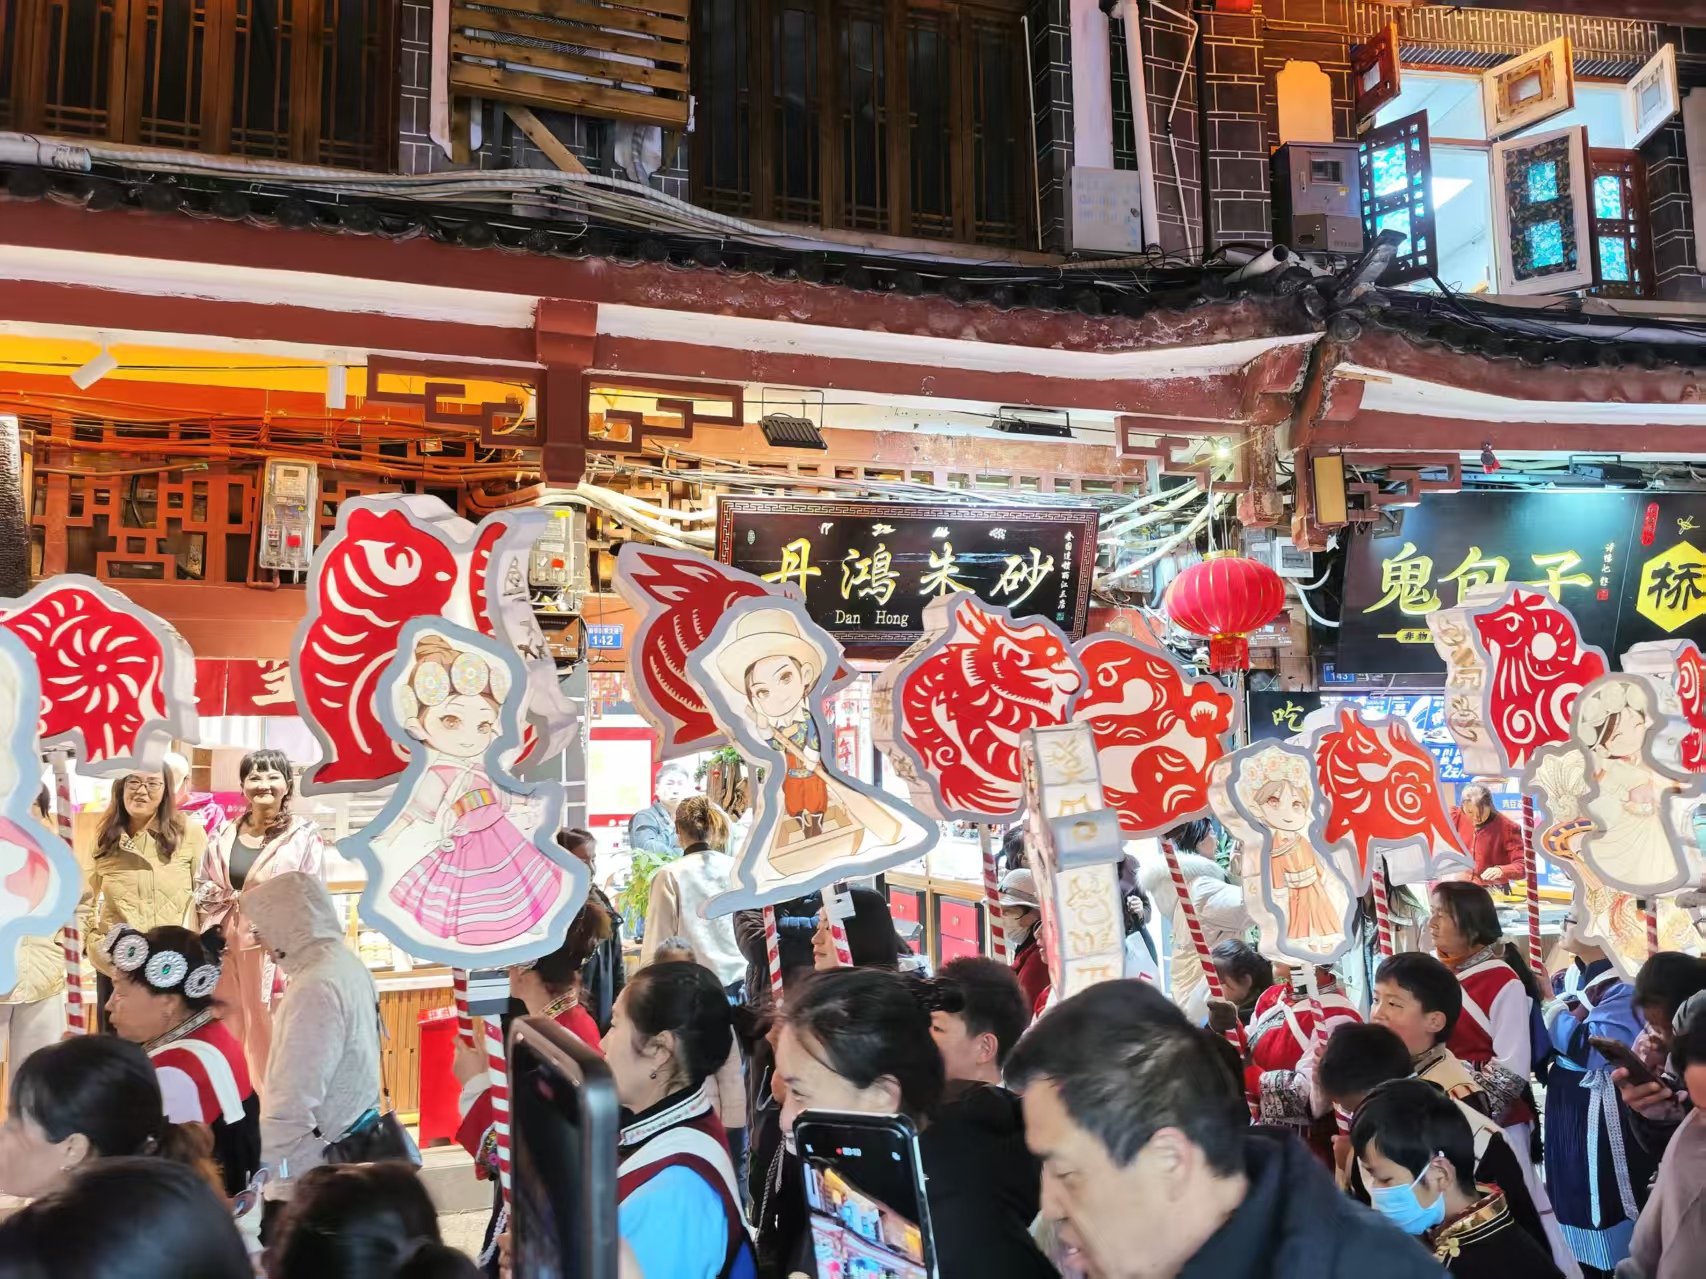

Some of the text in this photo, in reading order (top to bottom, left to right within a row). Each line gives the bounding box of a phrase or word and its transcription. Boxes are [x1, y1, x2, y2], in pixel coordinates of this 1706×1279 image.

[1362, 541, 1593, 614] 鬼包子
[1647, 561, 1704, 611] 桥
[834, 609, 909, 628] Dan Hong
[592, 634, 614, 646] 142
[1403, 630, 1433, 641] 非物
[1331, 671, 1349, 681] 143
[1271, 700, 1305, 732] 吃
